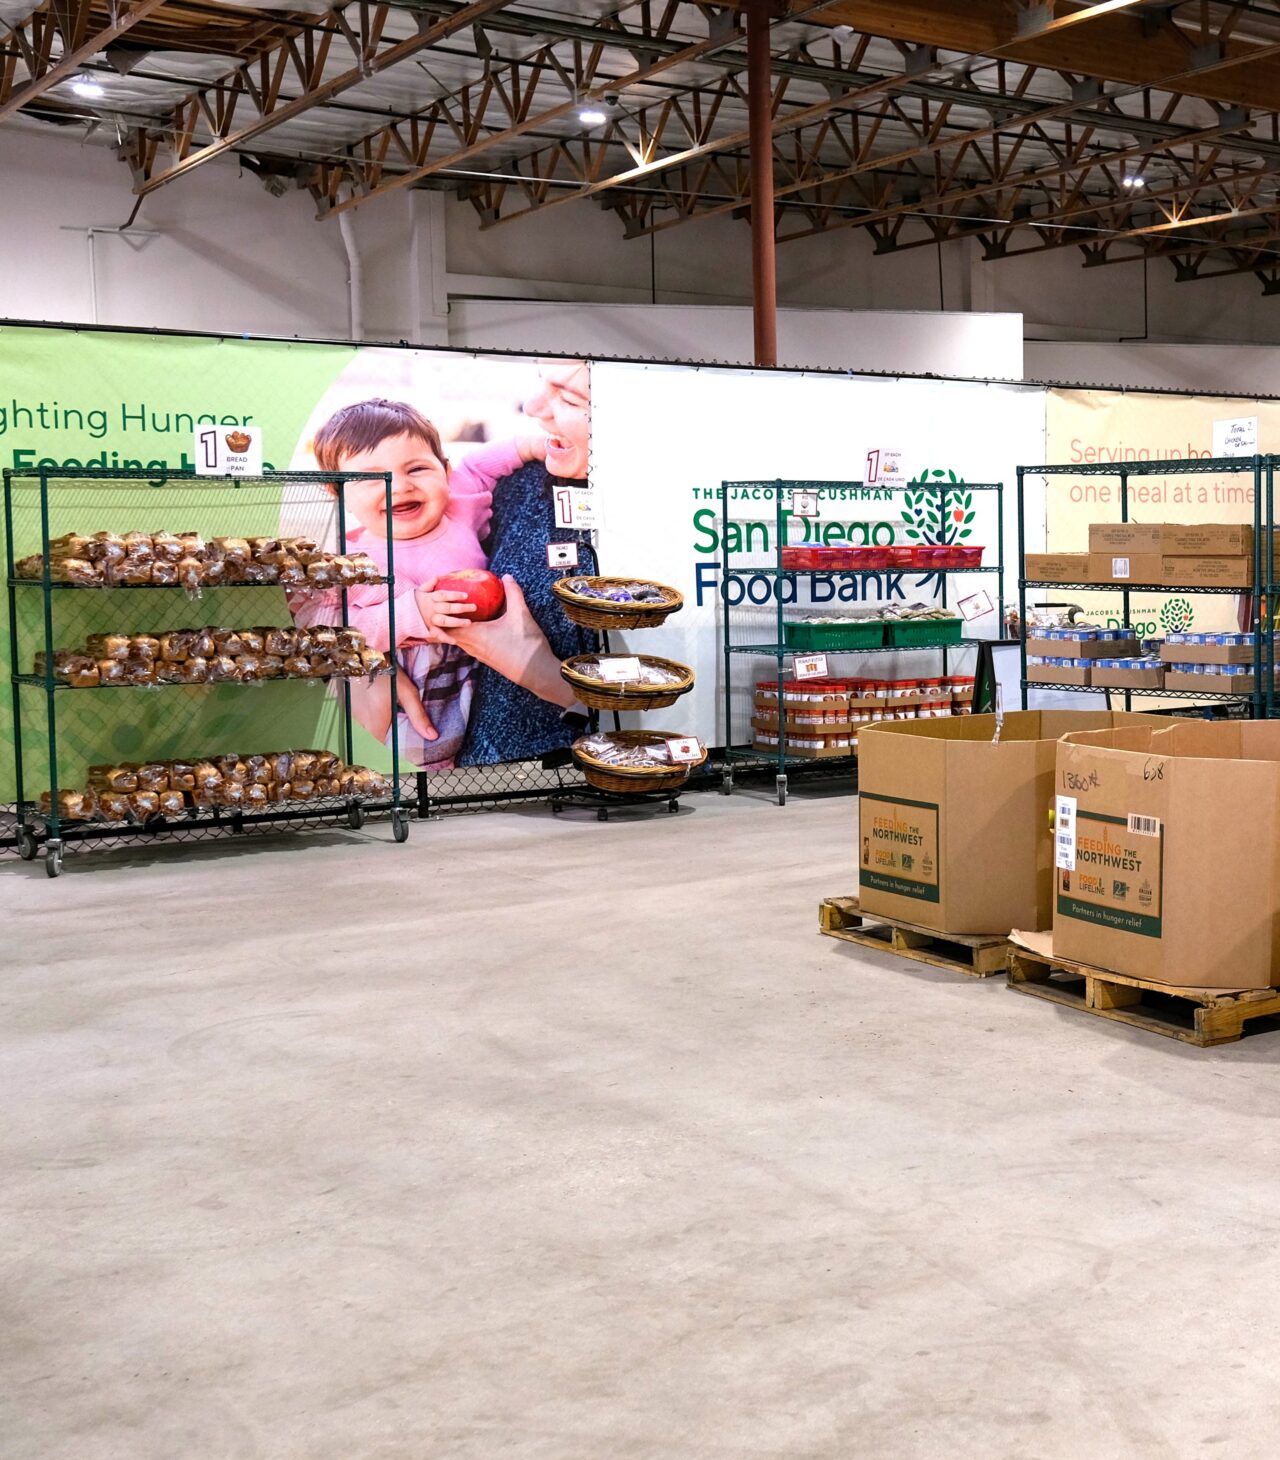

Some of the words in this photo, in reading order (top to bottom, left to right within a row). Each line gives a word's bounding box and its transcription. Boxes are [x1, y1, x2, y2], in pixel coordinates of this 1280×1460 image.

[200, 430, 218, 468] 1
[1070, 438, 1150, 463] Serving
[867, 449, 880, 482] 1
[692, 488, 723, 500] THE
[817, 488, 894, 500] CUSHMAN
[1070, 485, 1111, 503] one
[1117, 480, 1167, 503] meal
[1173, 482, 1192, 503] at
[1198, 487, 1207, 503] a
[1215, 482, 1256, 503] time
[556, 490, 573, 524] 1
[692, 508, 769, 553] San
[695, 562, 799, 607] Food
[810, 572, 906, 603] Bank
[1086, 609, 1114, 617] JACOBS
[1106, 618, 1157, 640] Digo
[873, 816, 908, 833] FEEDING
[909, 826, 920, 835] THE
[872, 827, 924, 847] NORTHWEST
[1077, 836, 1121, 856] FEEDING
[1123, 848, 1138, 859] THE
[875, 849, 890, 859] FOOD
[875, 856, 897, 868] LIFELINE
[1076, 848, 1142, 873] NORTHWEST
[870, 875, 889, 888] Partners
[894, 881, 911, 893] hunger
[911, 886, 926, 896] relief
[1079, 874, 1098, 885] FOOD
[1079, 882, 1105, 896] LIFELINE
[1072, 903, 1095, 918] Partners
[1095, 909, 1102, 918] in
[1102, 911, 1124, 925] hunger
[1125, 917, 1143, 929] relief
